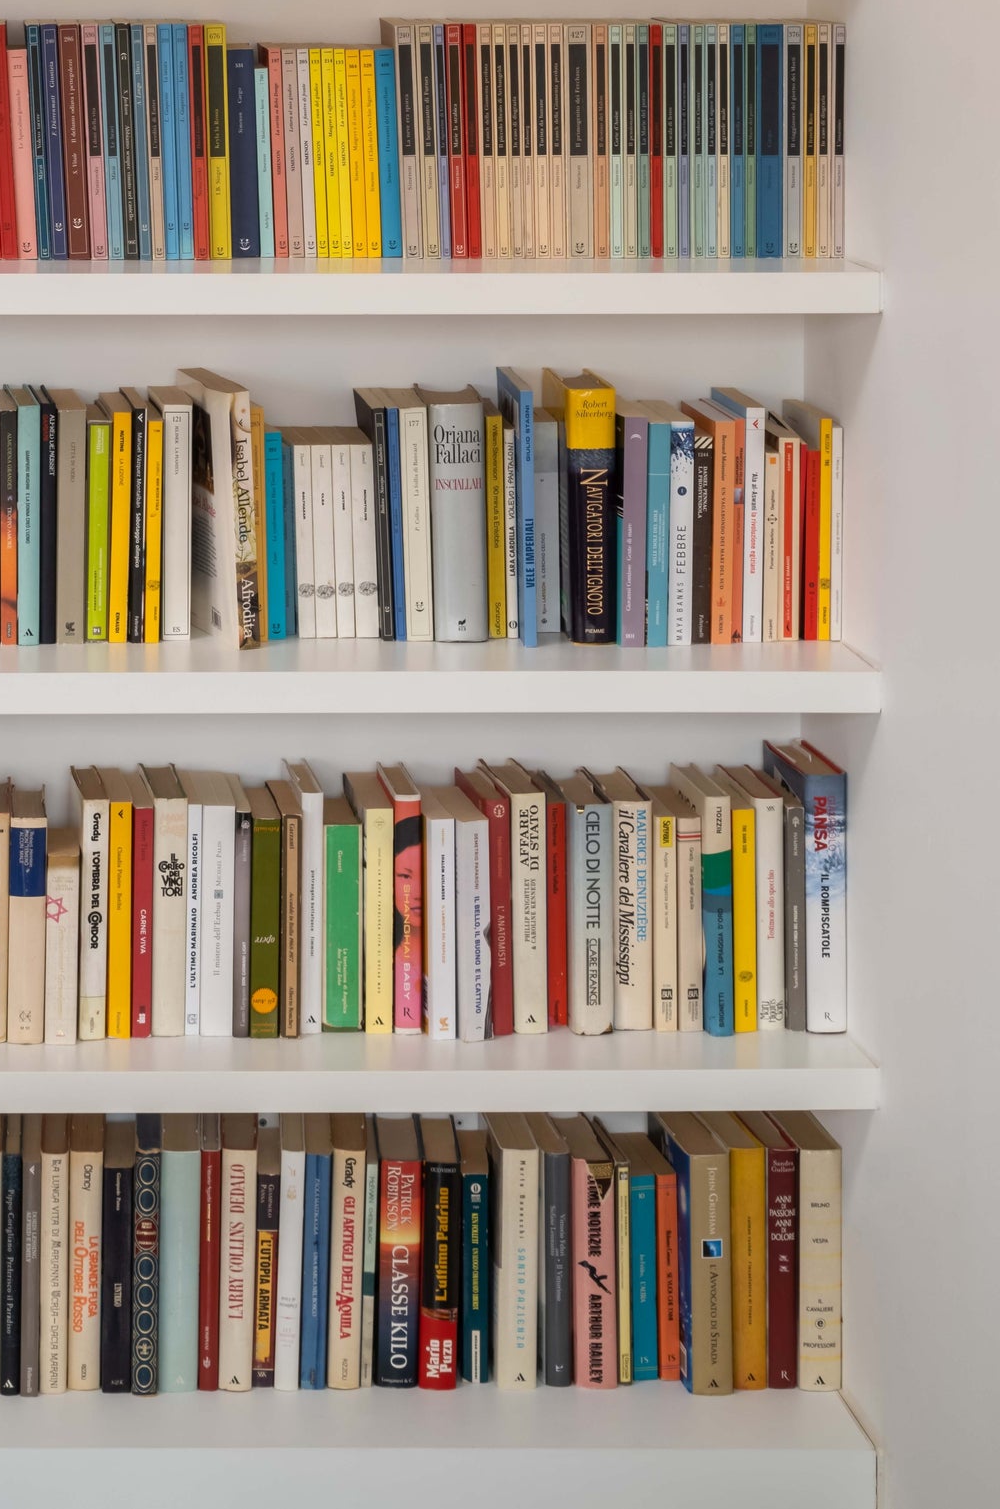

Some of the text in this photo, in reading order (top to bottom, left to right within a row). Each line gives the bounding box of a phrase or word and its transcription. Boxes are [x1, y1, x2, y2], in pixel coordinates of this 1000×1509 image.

[434, 424, 480, 443] Oriana
[576, 410, 613, 419] Silverberg
[436, 444, 482, 464] Fallaci
[235, 438, 250, 544] Isabel Allende
[435, 477, 483, 491] INSCIALLAH
[580, 467, 608, 615] NAVIGATORI DELL'IGNOTO
[676, 526, 686, 574] FEBBRE
[526, 568, 534, 588] VELE
[240, 578, 255, 640] Afrodita
[92, 813, 100, 841] Grady
[520, 809, 528, 866] AFFARE
[530, 805, 538, 870] DI STATO
[635, 809, 646, 862] MAURICE
[813, 796, 827, 852] PANSA
[92, 851, 100, 891] L'OMBRA
[586, 811, 600, 929] CIELO DI NOTTE
[91, 894, 100, 908] DEL
[616, 809, 634, 986] il Cavaliere del Mississippi
[820, 872, 831, 958] IL ROMPISCATOLE
[402, 885, 412, 999] SHANGHAI BABY
[589, 970, 598, 1006] FRANCIS
[82, 1164, 92, 1191] Clancy
[230, 1164, 244, 1213] DEDALO
[343, 1158, 356, 1188] Grady
[386, 1166, 401, 1231] ROBINSON
[401, 1174, 414, 1224] PATRICK
[708, 1167, 717, 1235] JOHN GRISHAM
[229, 1222, 244, 1318] LARRY COLLINS
[435, 1187, 449, 1301] L'ultimo Padrino
[258, 1240, 272, 1331] L'UTOPIA ARMATA
[391, 1245, 408, 1369] CLASSE KILO
[426, 1339, 440, 1378] Mario
[441, 1339, 454, 1373] Puzo
[589, 1294, 603, 1384] ARTHUR HAILEY
